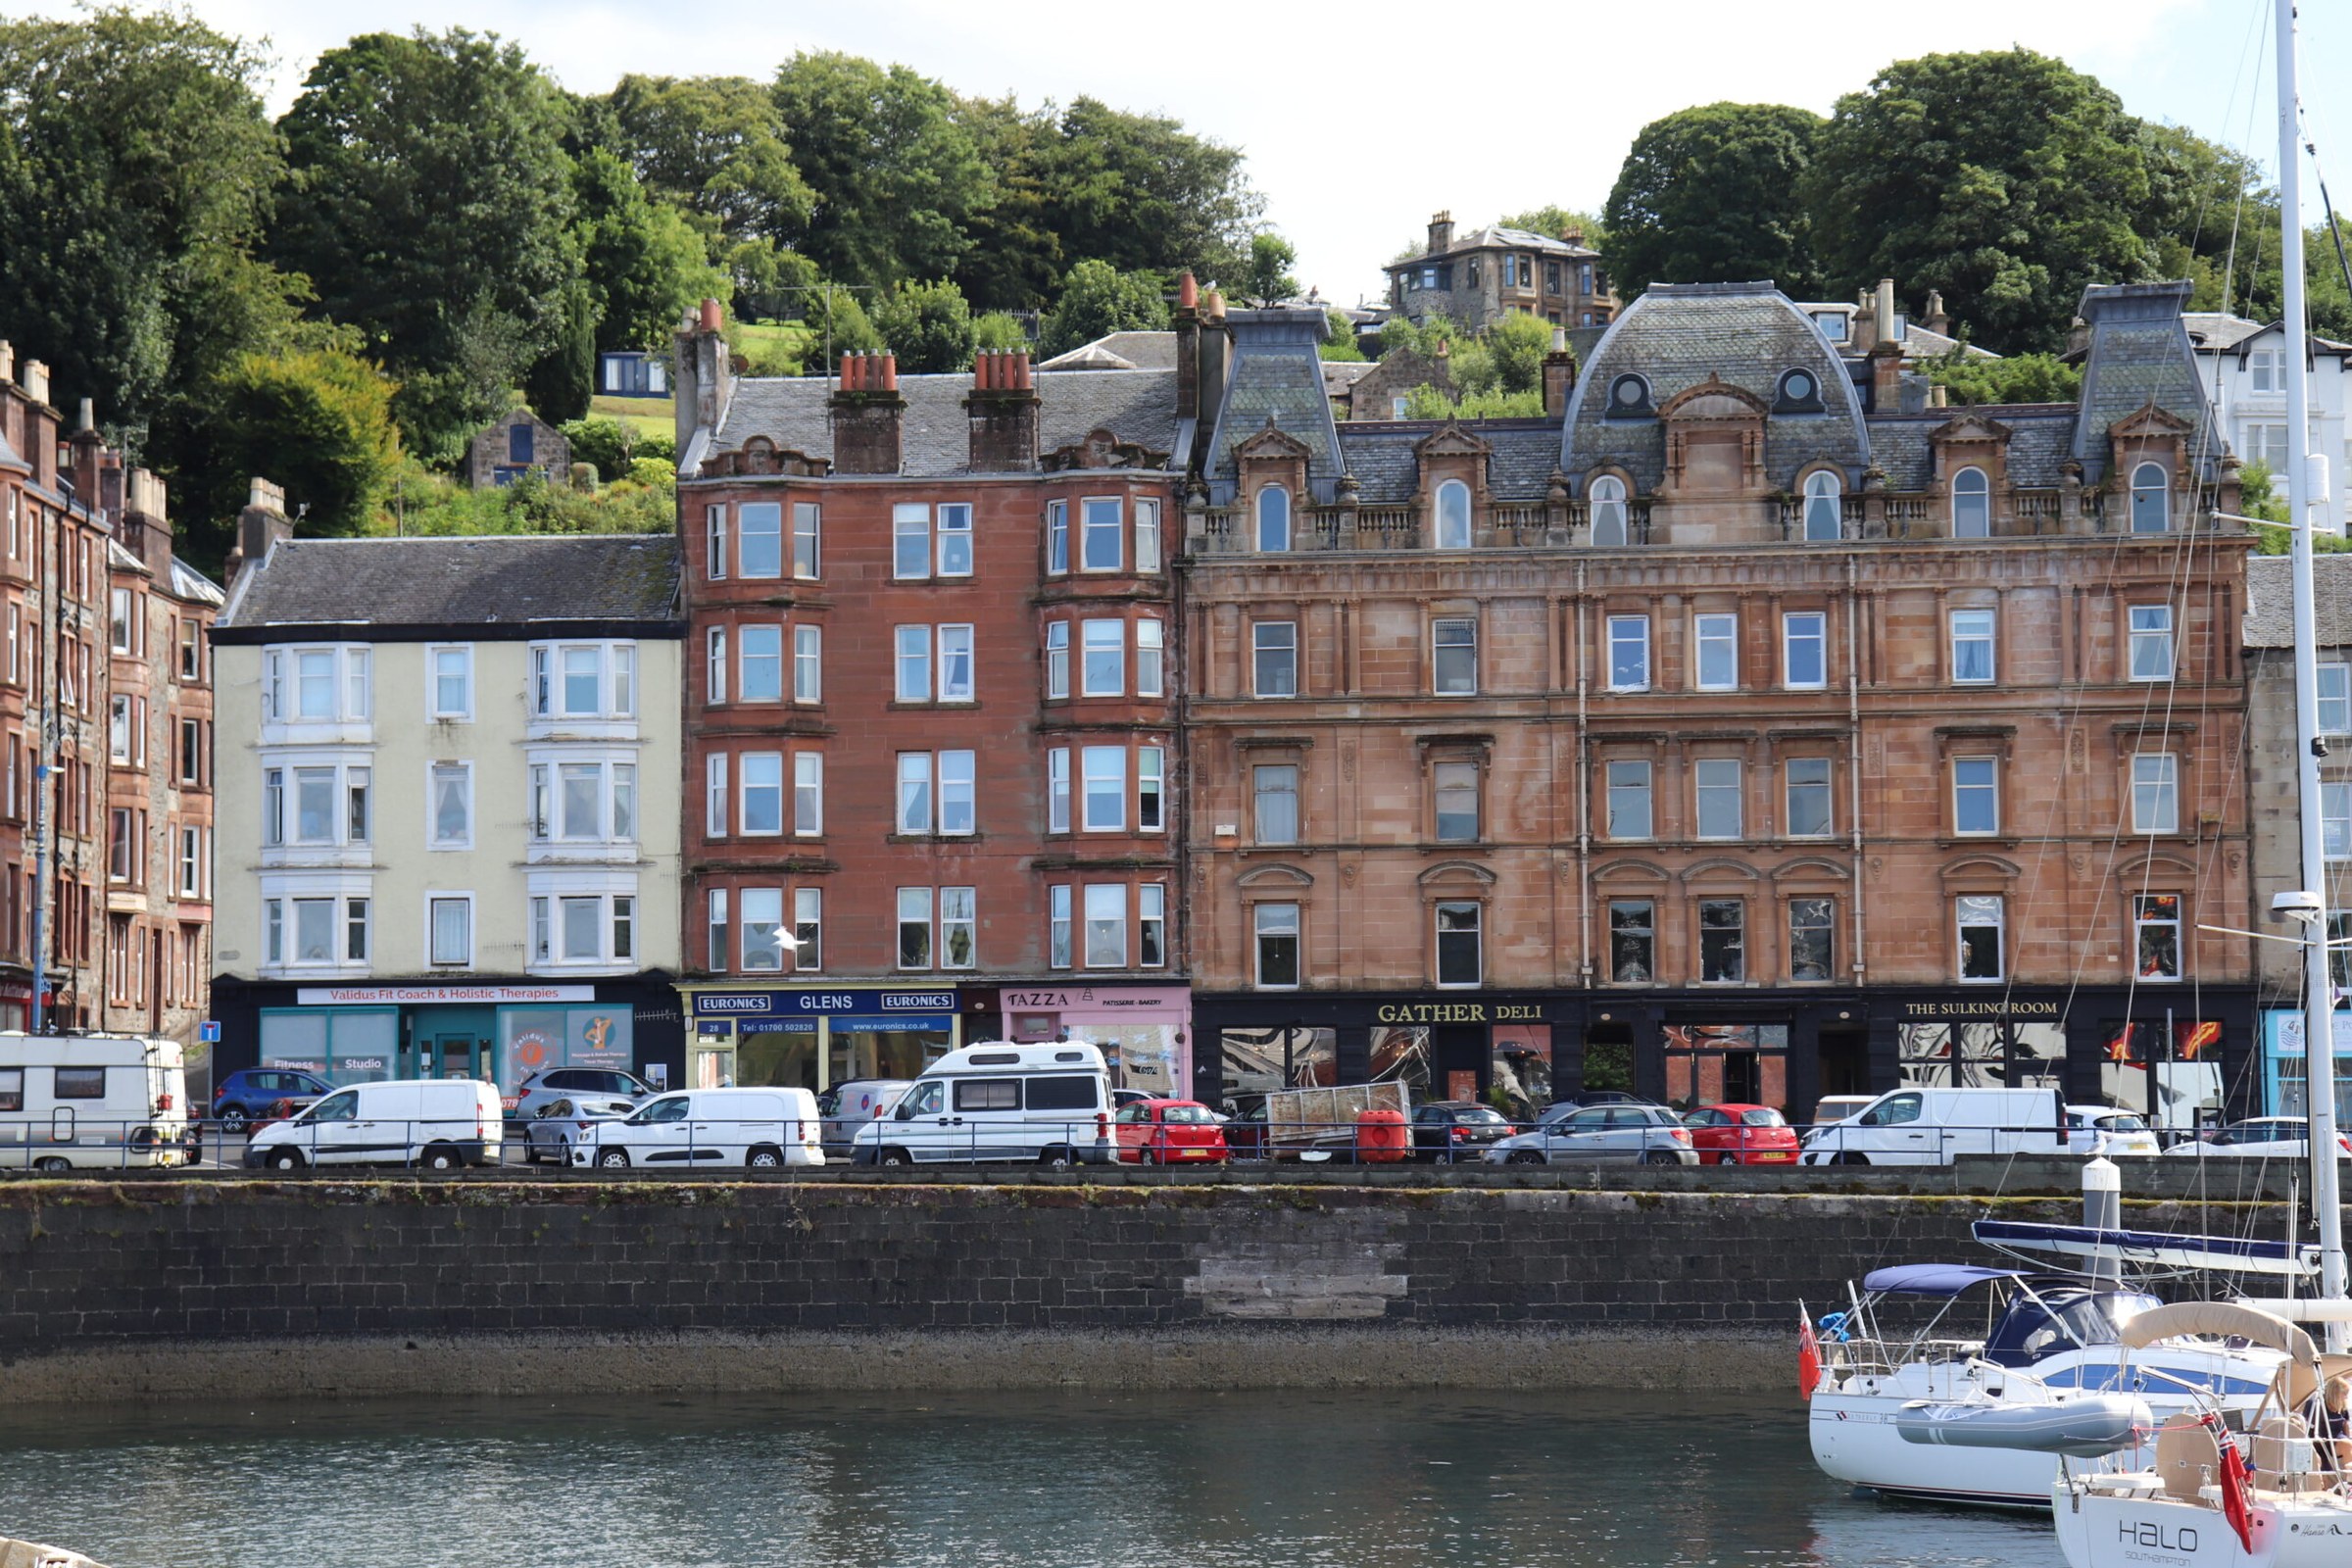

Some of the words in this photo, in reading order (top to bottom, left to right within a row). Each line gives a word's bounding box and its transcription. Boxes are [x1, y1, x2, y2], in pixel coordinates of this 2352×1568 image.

[330, 990, 376, 1000] Validus
[378, 990, 393, 1000] Fit
[397, 989, 435, 1000] Coach
[437, 989, 446, 999] &
[450, 989, 495, 1000] Holistic
[498, 988, 559, 1000] Therapies
[1007, 993, 1068, 1006] TAZZA
[703, 998, 766, 1009] EURONICS
[800, 996, 853, 1009] GLENS
[886, 995, 950, 1006] EURONICS
[1378, 1004, 1487, 1022] GATHER
[1496, 1005, 1542, 1019] DELI
[1906, 1003, 1936, 1015] THE
[1941, 1003, 2008, 1015] SULKING
[2011, 1002, 2057, 1013] ROOM
[709, 1024, 719, 1033] 28
[785, 1023, 813, 1032] 502820
[853, 1022, 929, 1031] www.euronics.co.uk
[274, 1059, 315, 1069] Fitness
[345, 1058, 381, 1069] Studio
